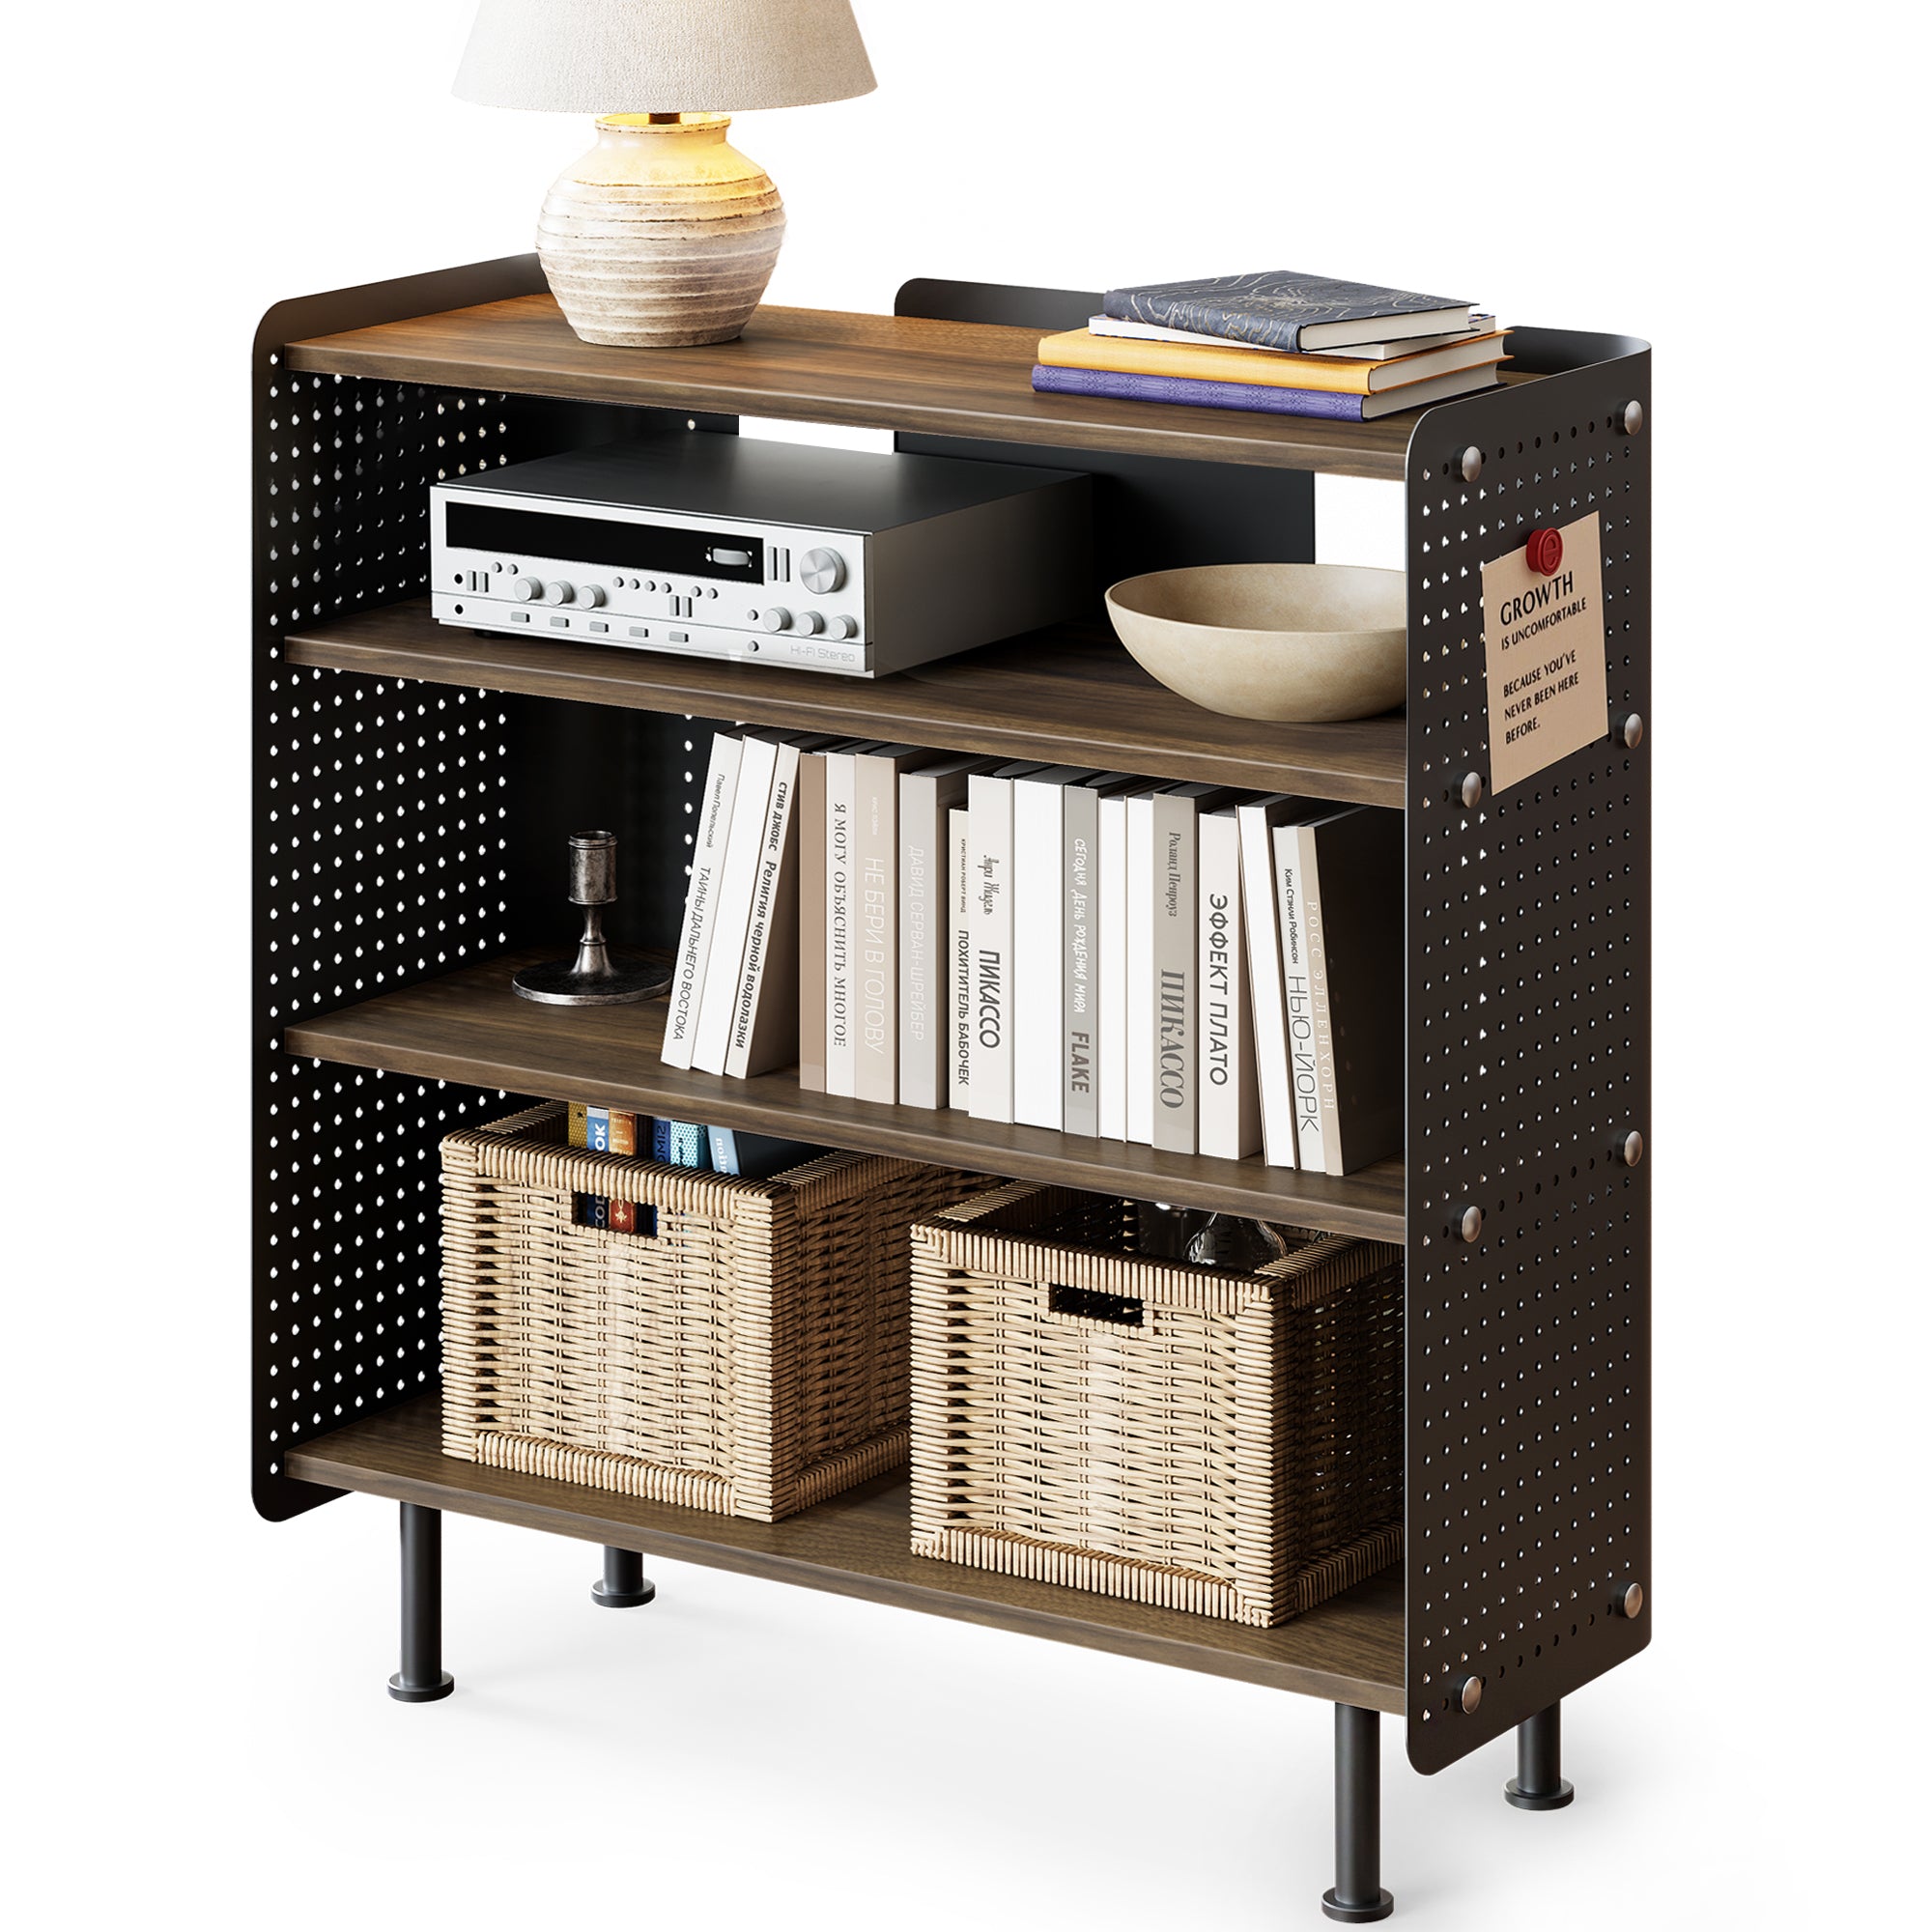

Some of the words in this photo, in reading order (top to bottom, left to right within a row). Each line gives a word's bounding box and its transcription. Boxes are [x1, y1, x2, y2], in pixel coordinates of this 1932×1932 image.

[1500, 571, 1573, 626] GROWTH
[1502, 636, 1509, 650] IS
[1511, 597, 1586, 645] UNCOMFORTABLE
[818, 648, 856, 663] Stereo
[1504, 668, 1541, 697] BECAUSE
[1505, 697, 1531, 720] NEVER
[1533, 683, 1557, 706] BEEN
[1558, 672, 1578, 693] HERE
[1506, 717, 1540, 744] BEFORE.
[713, 773, 725, 798] Павел
[835, 803, 846, 813] Я
[705, 800, 721, 850] Попельский
[835, 818, 847, 865] МОГУ
[1167, 832, 1180, 871] Роланд
[756, 861, 779, 920] Религия
[865, 858, 884, 885] НЕ
[908, 845, 926, 896] ДАВИД
[1165, 873, 1180, 917] Пенроуз
[834, 871, 847, 971] ОБЪЯСНИТЬ
[865, 890, 886, 944] БЕРИ
[1070, 889, 1087, 920] ДЕНЬ
[1286, 888, 1295, 921] Стэнли
[1306, 900, 1322, 958] РОСС
[682, 911, 703, 980] ДАЛЬНЕГО
[746, 921, 765, 973] черной
[866, 950, 886, 964] В
[1071, 924, 1088, 980] РОЖДЕНИЯ
[1208, 893, 1229, 995] ЭФФЕКТ
[1289, 921, 1298, 964] Робинсон
[909, 902, 926, 1042] СЕРВАН-ШРЕЙБЕР
[958, 929, 971, 1020] ПОХИТИТЕЛЬ
[978, 950, 1001, 1048] ПИКАССО
[1074, 983, 1086, 1012] МИРА
[673, 981, 693, 1039] ВОСТОКА
[733, 972, 757, 1051] водолазки
[834, 977, 846, 1046] МНОГОЕ
[865, 969, 886, 1055] ГОЛОВУ
[958, 1022, 971, 1086] БАБОЧЕК
[1071, 1032, 1090, 1093] FLAKE
[1159, 969, 1184, 1108] ПИКАССО
[1209, 1002, 1228, 1086] ПЛАТО
[1289, 976, 1319, 1131] НЬЮ-ЙОРК
[1313, 968, 1337, 1110] ЭЛЛЕНХОРН
